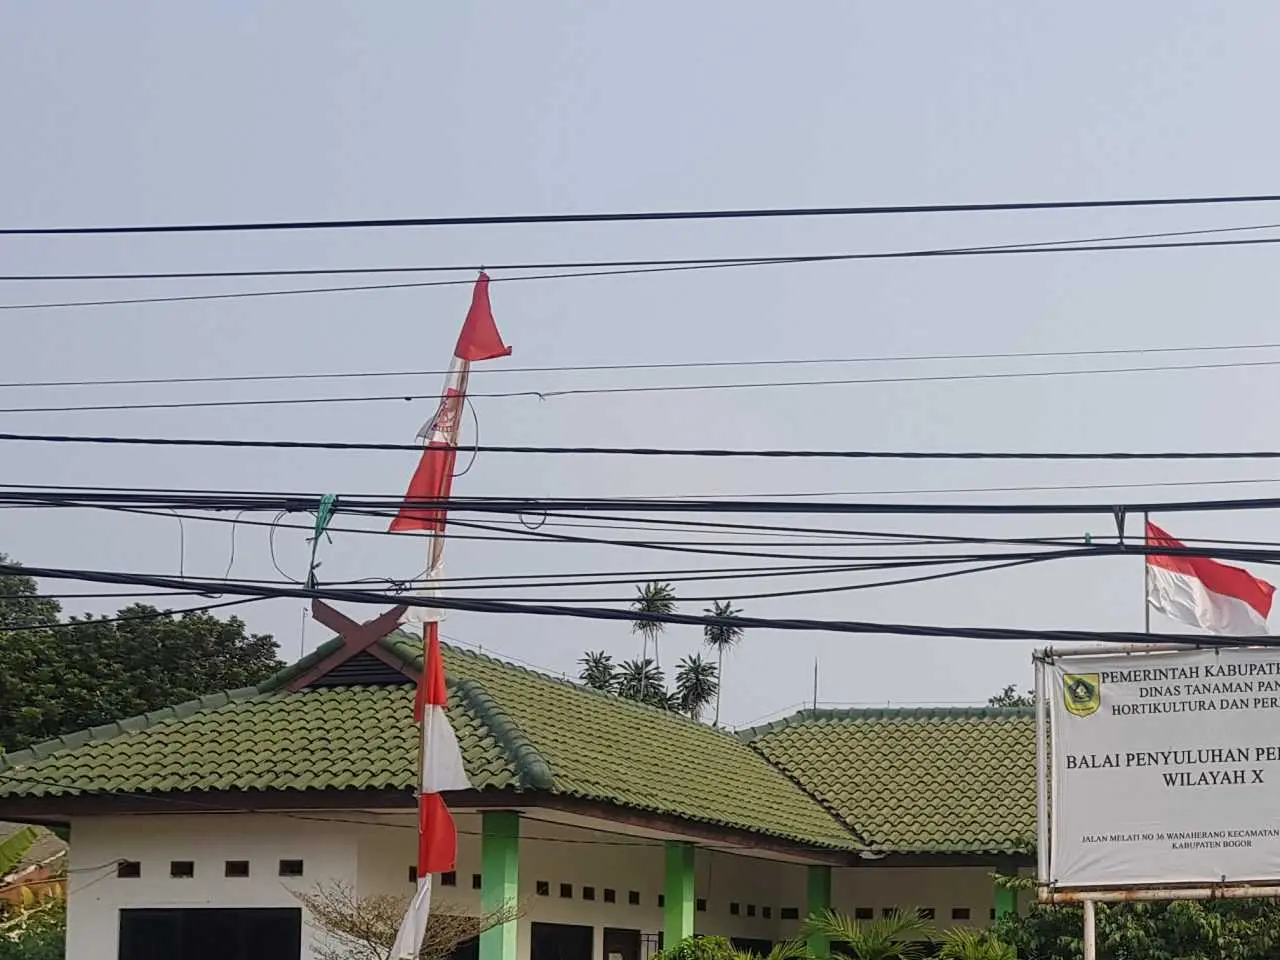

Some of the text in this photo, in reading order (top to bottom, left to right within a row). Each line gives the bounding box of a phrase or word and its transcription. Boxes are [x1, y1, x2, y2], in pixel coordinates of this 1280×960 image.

[1101, 667, 1199, 683] PEMERINTAH
[1138, 684, 1182, 699] DINAS
[1185, 681, 1253, 695] TANAMAN
[1112, 700, 1216, 715] HORTIKULTURA
[1219, 697, 1250, 711] DAN
[1066, 754, 1120, 769] BALAI
[1126, 748, 1249, 767] PENYULUHAN
[1162, 769, 1265, 786] WILAYAH X
[1081, 834, 1109, 844] JALAN
[1108, 832, 1140, 843] MELATI
[1141, 832, 1155, 841] NO
[1155, 832, 1165, 841] 36
[1166, 830, 1227, 843] WANAHERANG
[1226, 828, 1280, 839] KECAMATAN
[1171, 839, 1253, 850] KABUPATEN BOGOR
